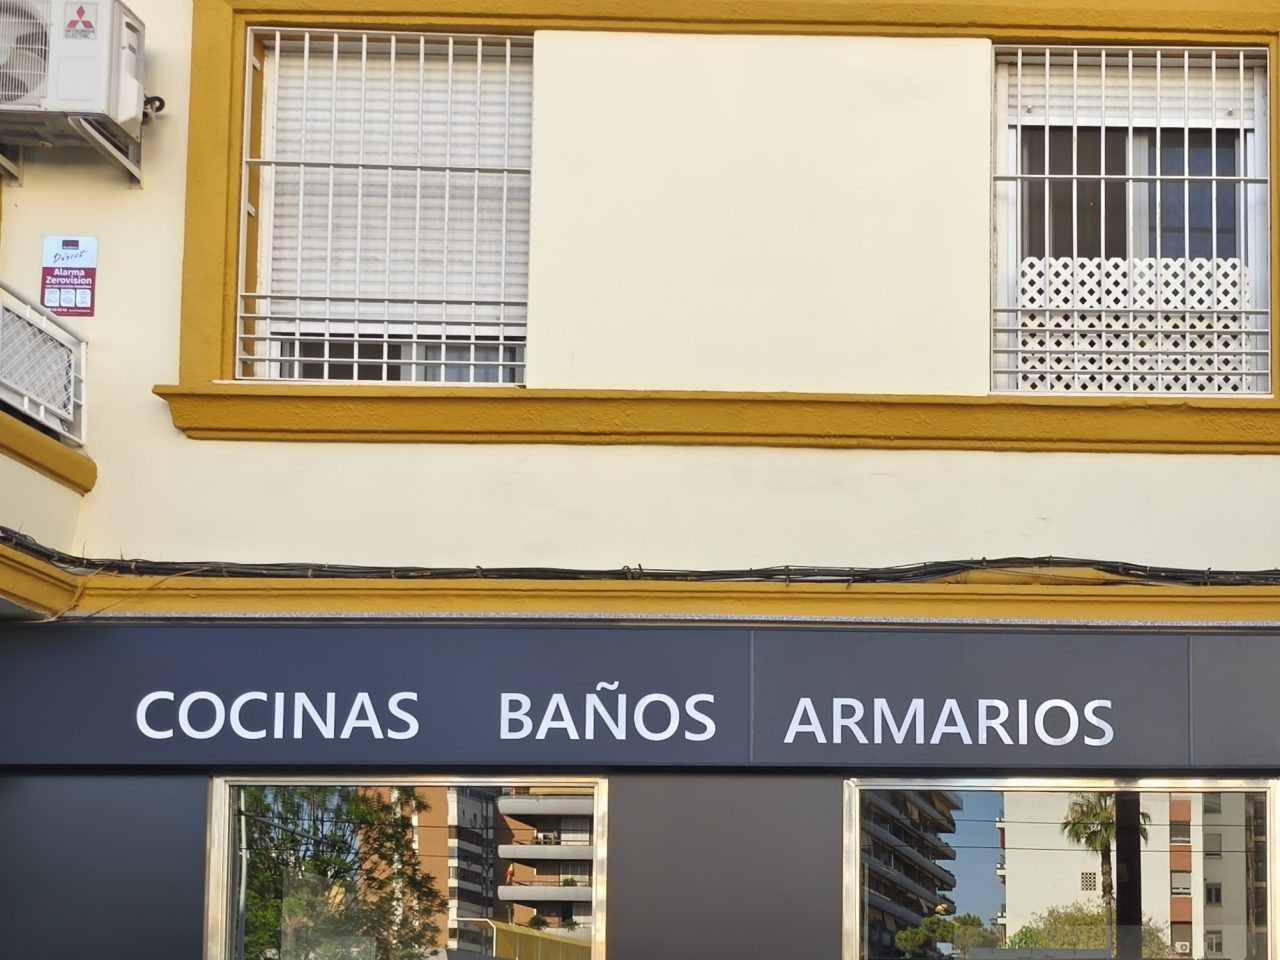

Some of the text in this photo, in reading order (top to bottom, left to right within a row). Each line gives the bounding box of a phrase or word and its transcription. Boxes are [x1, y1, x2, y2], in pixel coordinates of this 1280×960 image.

[54, 268, 85, 276] Alarma
[45, 275, 92, 284] Zerovision
[136, 680, 1115, 748] COCINAS BAÑOS ARMARIOS
